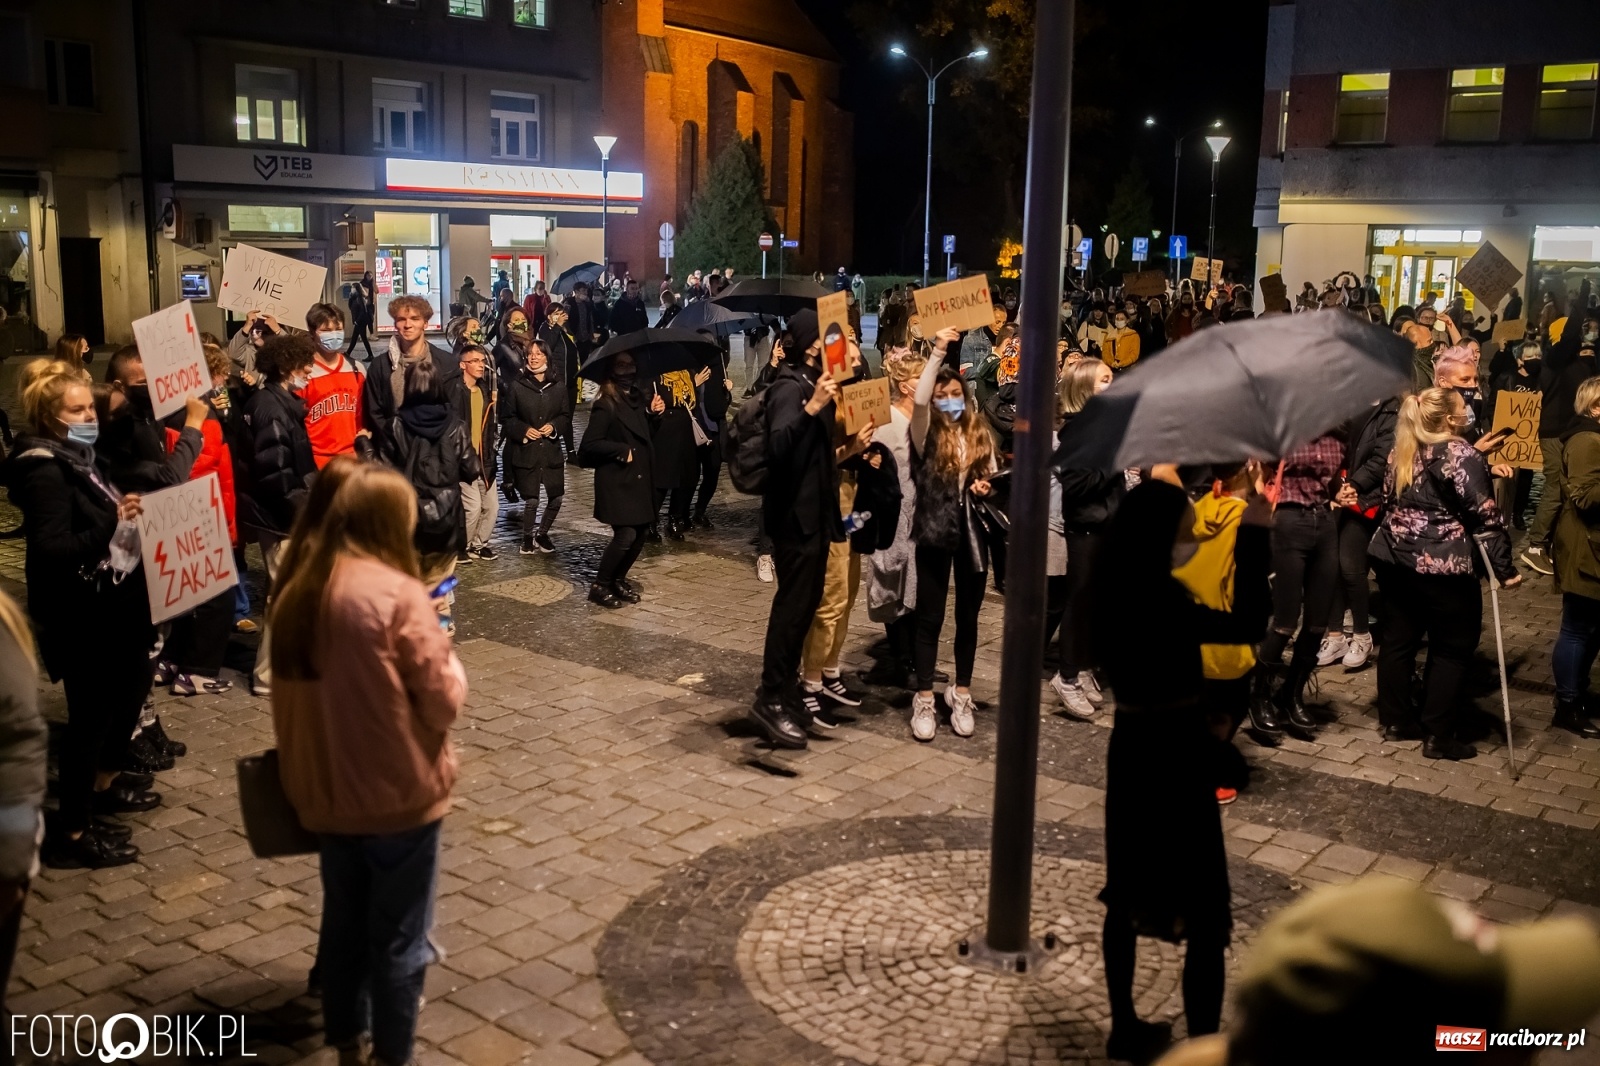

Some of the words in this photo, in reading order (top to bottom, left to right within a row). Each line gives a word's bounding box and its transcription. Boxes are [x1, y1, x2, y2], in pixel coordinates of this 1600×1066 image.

[280, 155, 313, 171] TEB
[280, 171, 313, 179] EDUKACJA
[244, 251, 308, 289] WYBÓR
[253, 276, 283, 300] NIE
[231, 292, 290, 321] ZAKAZ
[1494, 441, 1542, 463] KOBIE
[175, 526, 205, 561] NIE
[159, 547, 230, 608] ZAKAZ
